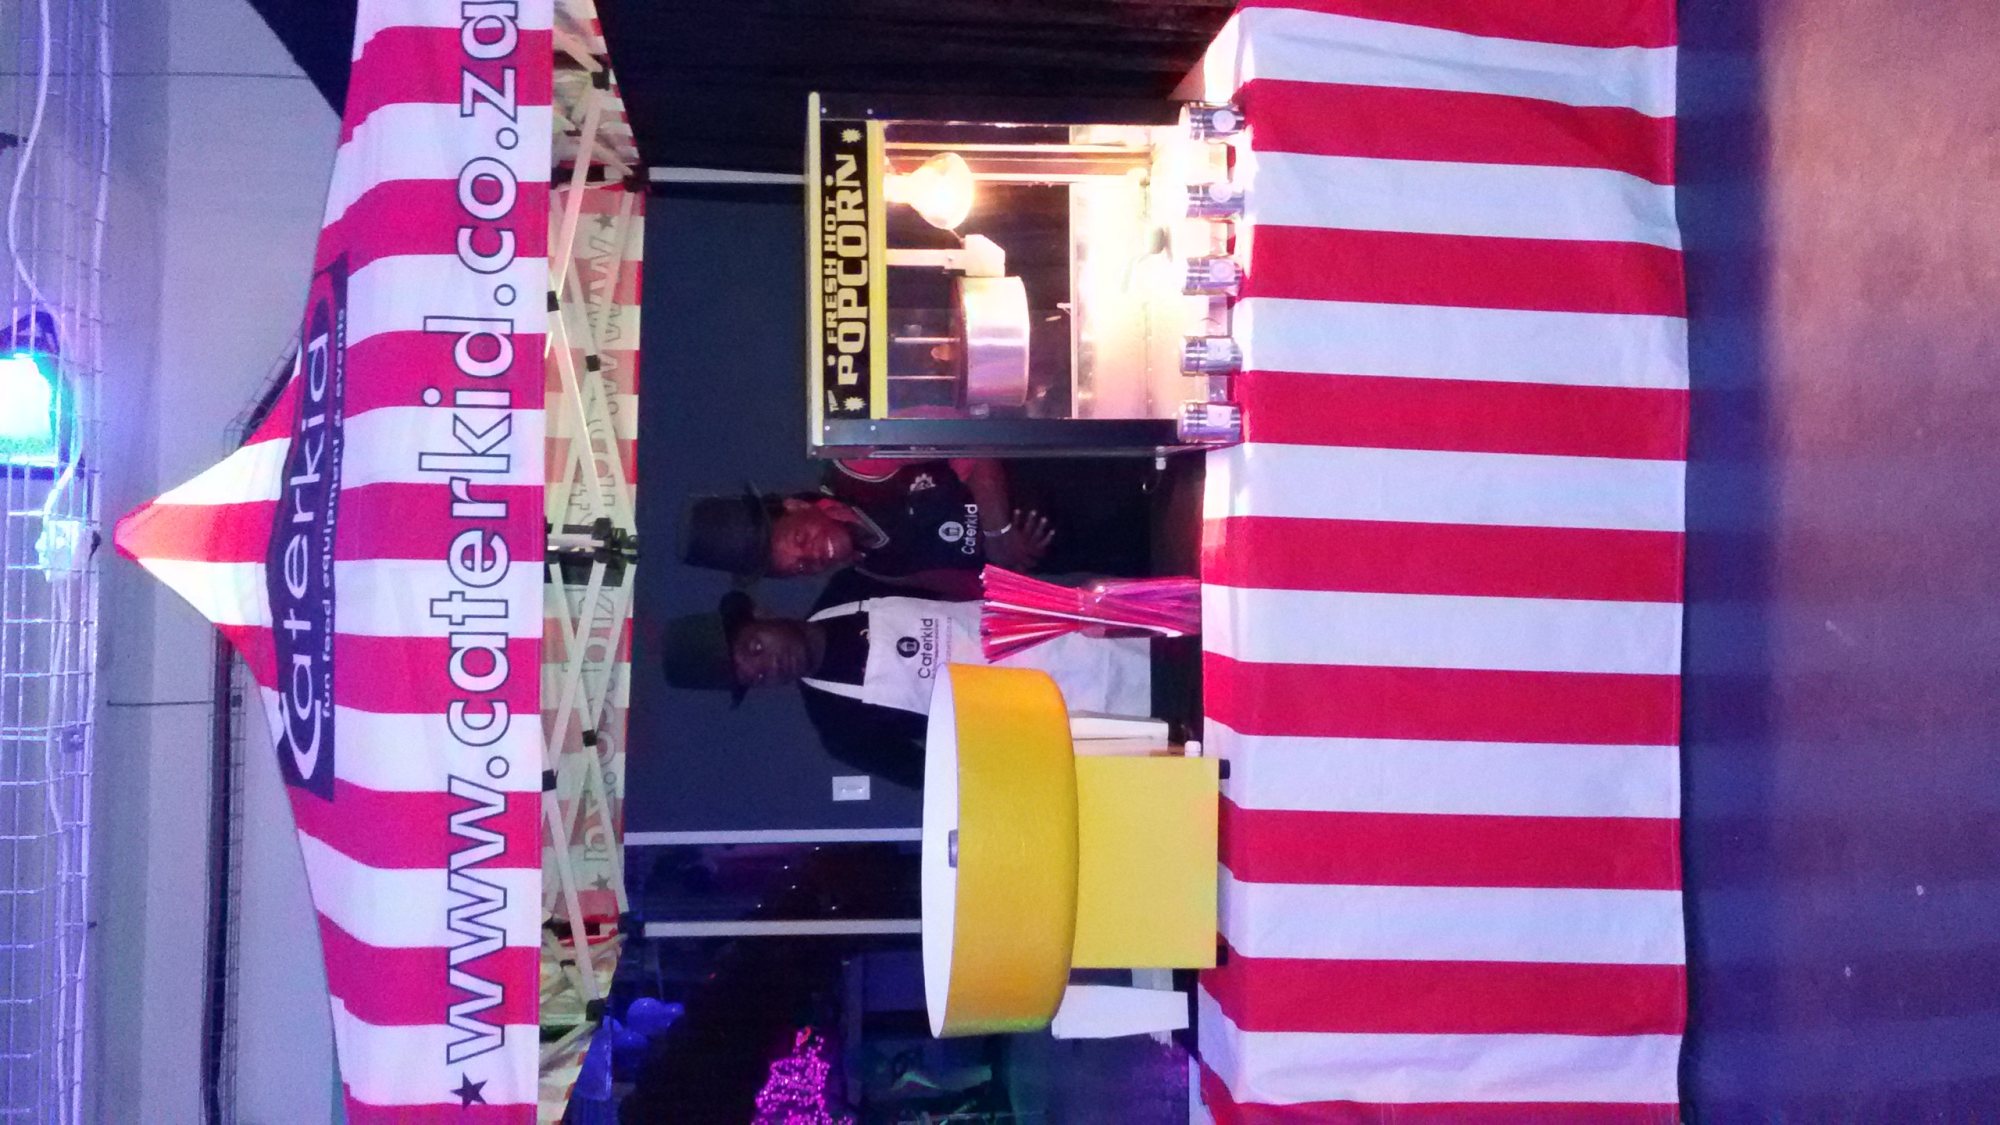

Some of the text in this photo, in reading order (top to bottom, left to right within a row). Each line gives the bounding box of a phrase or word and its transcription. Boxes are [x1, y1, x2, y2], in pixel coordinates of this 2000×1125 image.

[824, 195, 837, 344] FRESH HOT
[835, 153, 868, 385] POPCORN
[281, 333, 329, 780] Caterkid
[322, 438, 340, 588] equipment
[418, 1, 519, 1065] www.caterkid.co.za
[961, 504, 978, 555] Caterkid
[322, 599, 331, 662] food
[322, 672, 331, 717] fun
[917, 618, 933, 679] Caterkid
